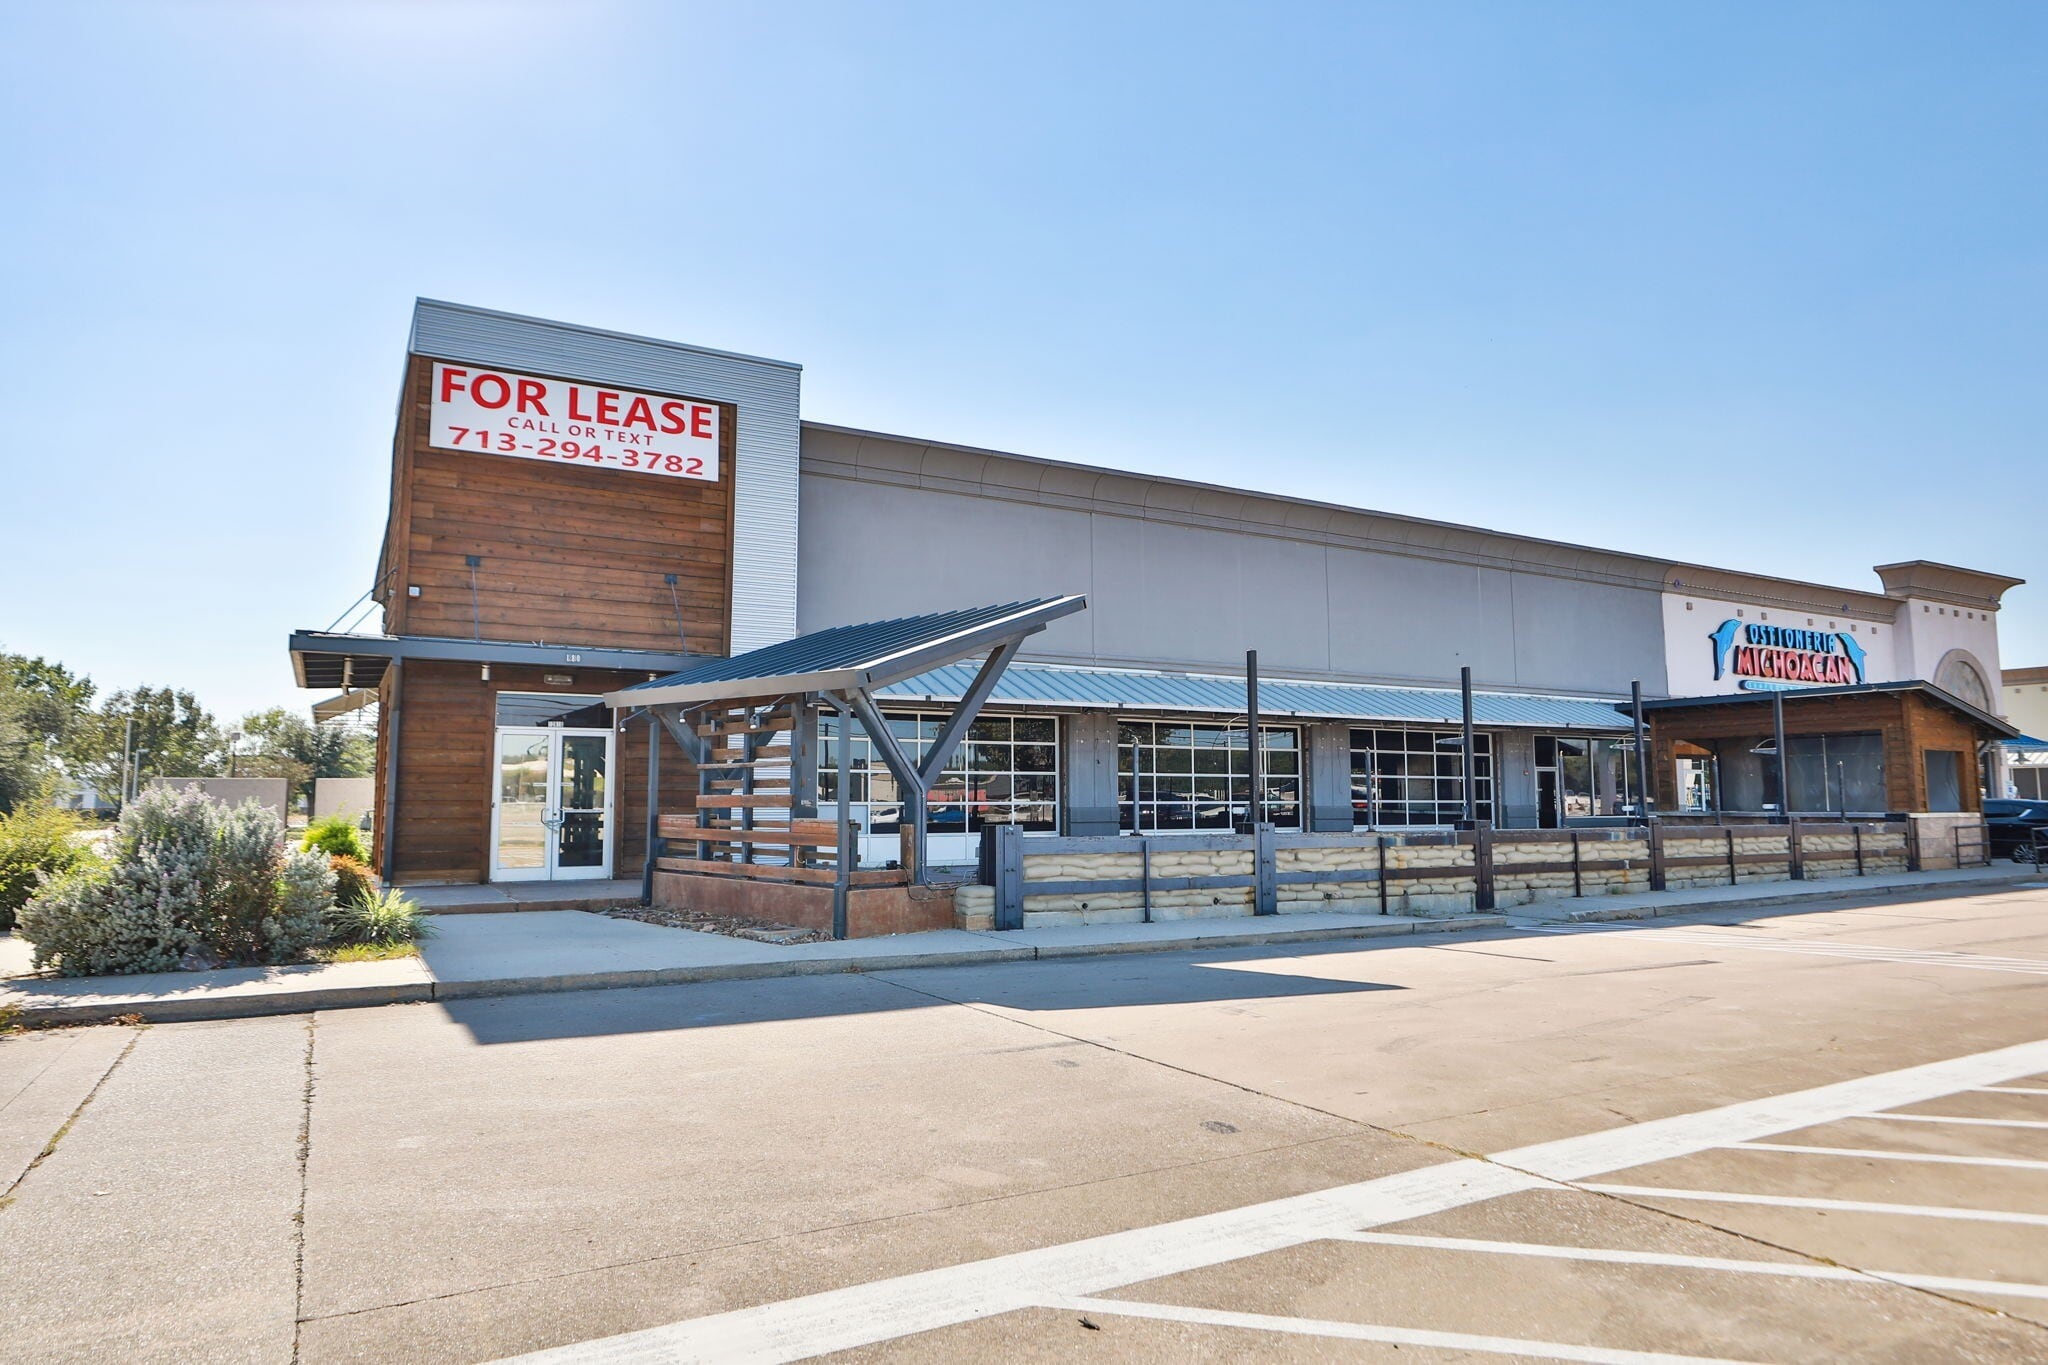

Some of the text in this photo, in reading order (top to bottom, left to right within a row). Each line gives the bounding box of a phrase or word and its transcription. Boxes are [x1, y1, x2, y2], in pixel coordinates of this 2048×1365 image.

[440, 367, 713, 440] FOR LEASE
[448, 425, 704, 476] 713-294-3782
[507, 416, 655, 447] CALL OR TEXT
[1747, 623, 1837, 654] OSTIONERIA
[1734, 645, 1851, 684] MICHOACAN
